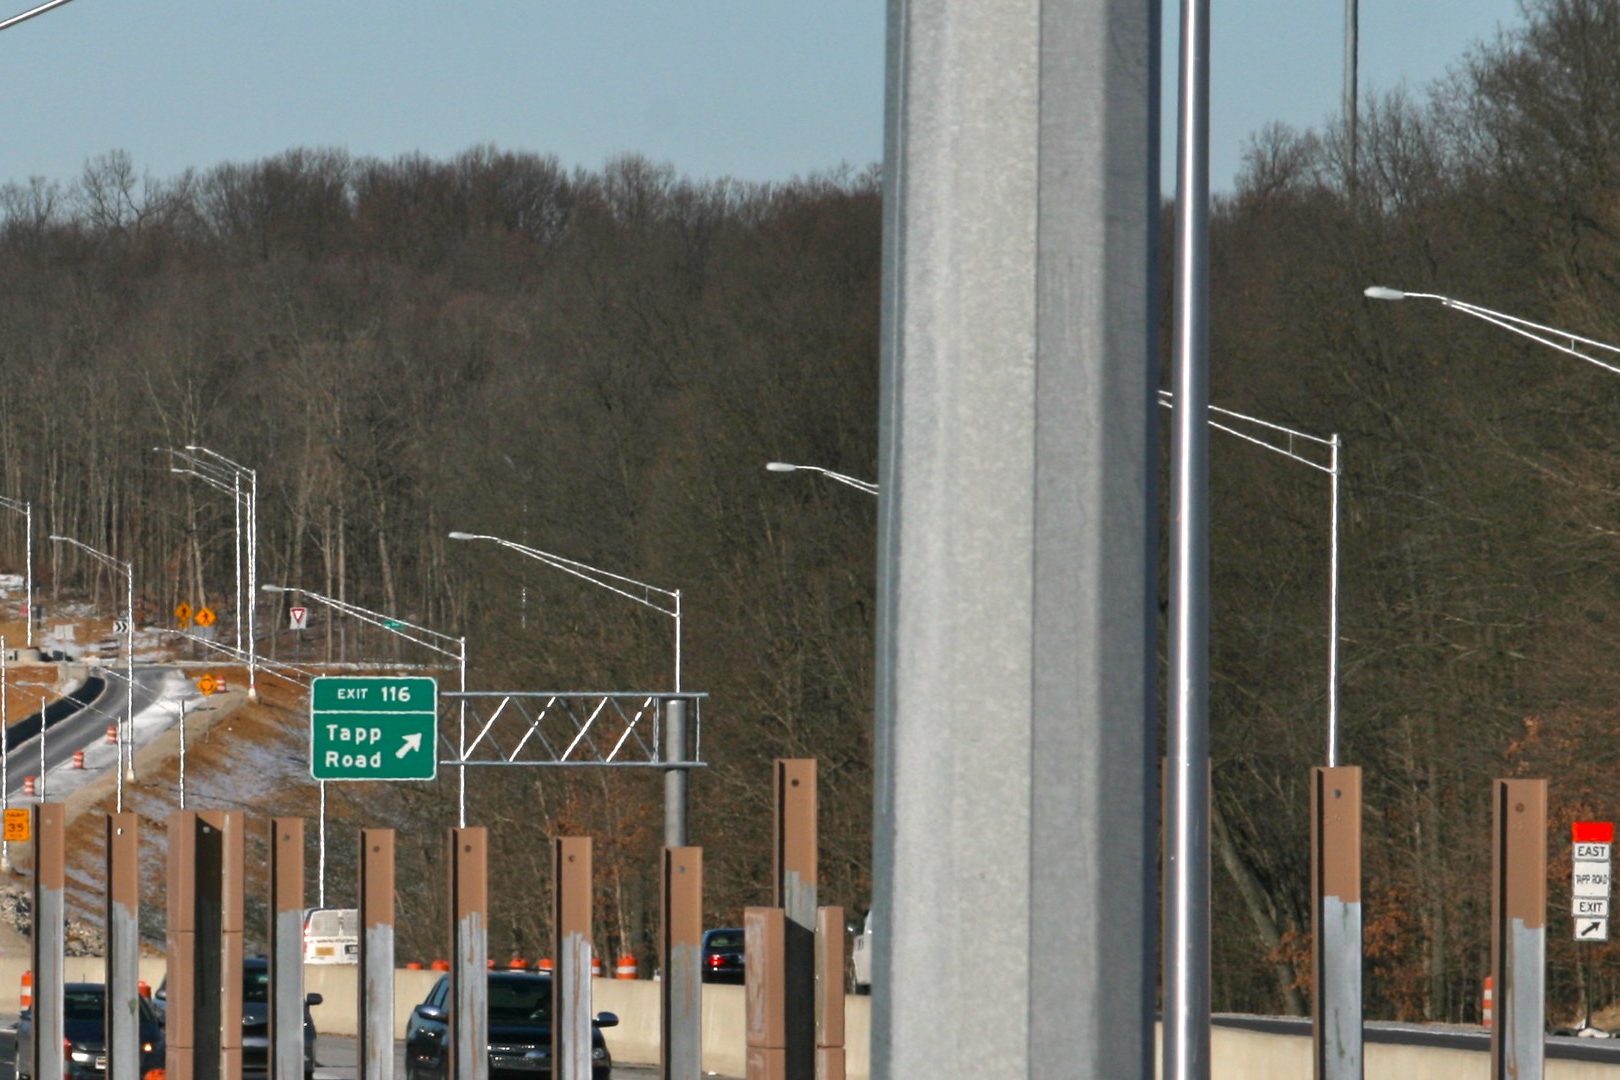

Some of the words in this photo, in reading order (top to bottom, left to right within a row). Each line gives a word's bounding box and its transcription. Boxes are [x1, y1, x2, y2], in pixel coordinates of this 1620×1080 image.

[337, 688, 369, 700] EXIT
[381, 686, 411, 702] 116
[326, 724, 382, 745] Tapp
[325, 751, 382, 768] Road
[8, 823, 25, 833] 35
[1577, 846, 1606, 857] EAST
[1576, 874, 1591, 885] TAPP
[1591, 874, 1608, 885] ROAD
[1579, 902, 1603, 913] EXIT
